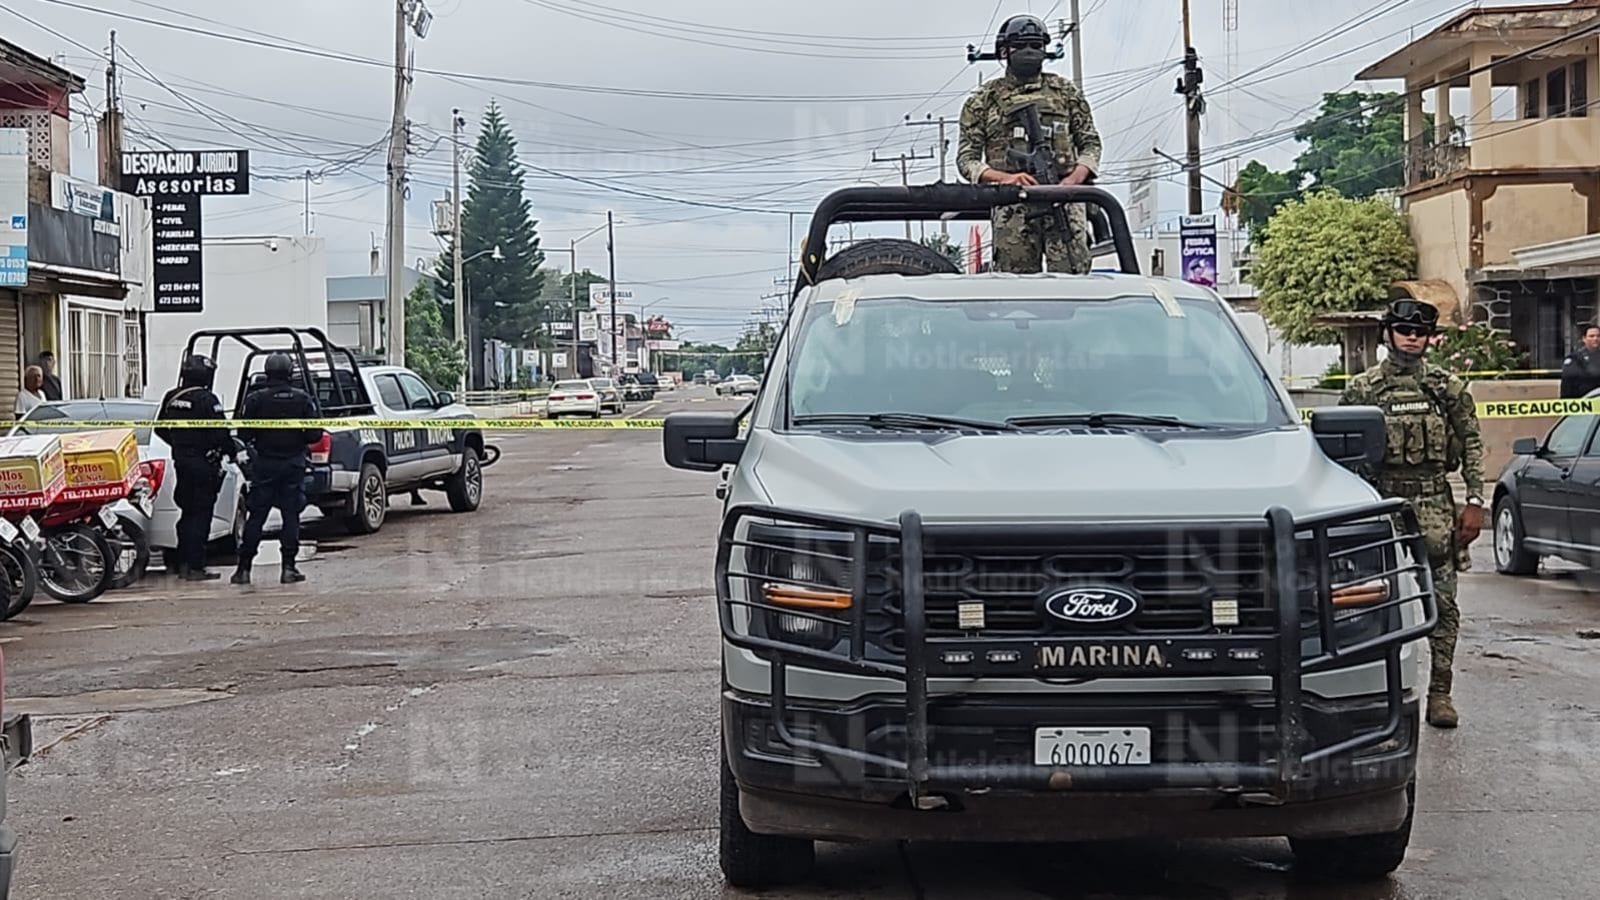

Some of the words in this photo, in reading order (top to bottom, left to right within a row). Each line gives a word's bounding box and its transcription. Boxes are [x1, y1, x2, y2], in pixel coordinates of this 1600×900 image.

[122, 153, 193, 174] DESPACHO
[136, 176, 236, 194] Asesorias
[1391, 402, 1430, 411] MARINA
[1486, 401, 1593, 415] PRECAUCIÓN
[71, 464, 104, 473] Pollos
[1063, 593, 1119, 616] Ford
[1042, 645, 1162, 667] MARINA
[1051, 743, 1135, 765] 600067
